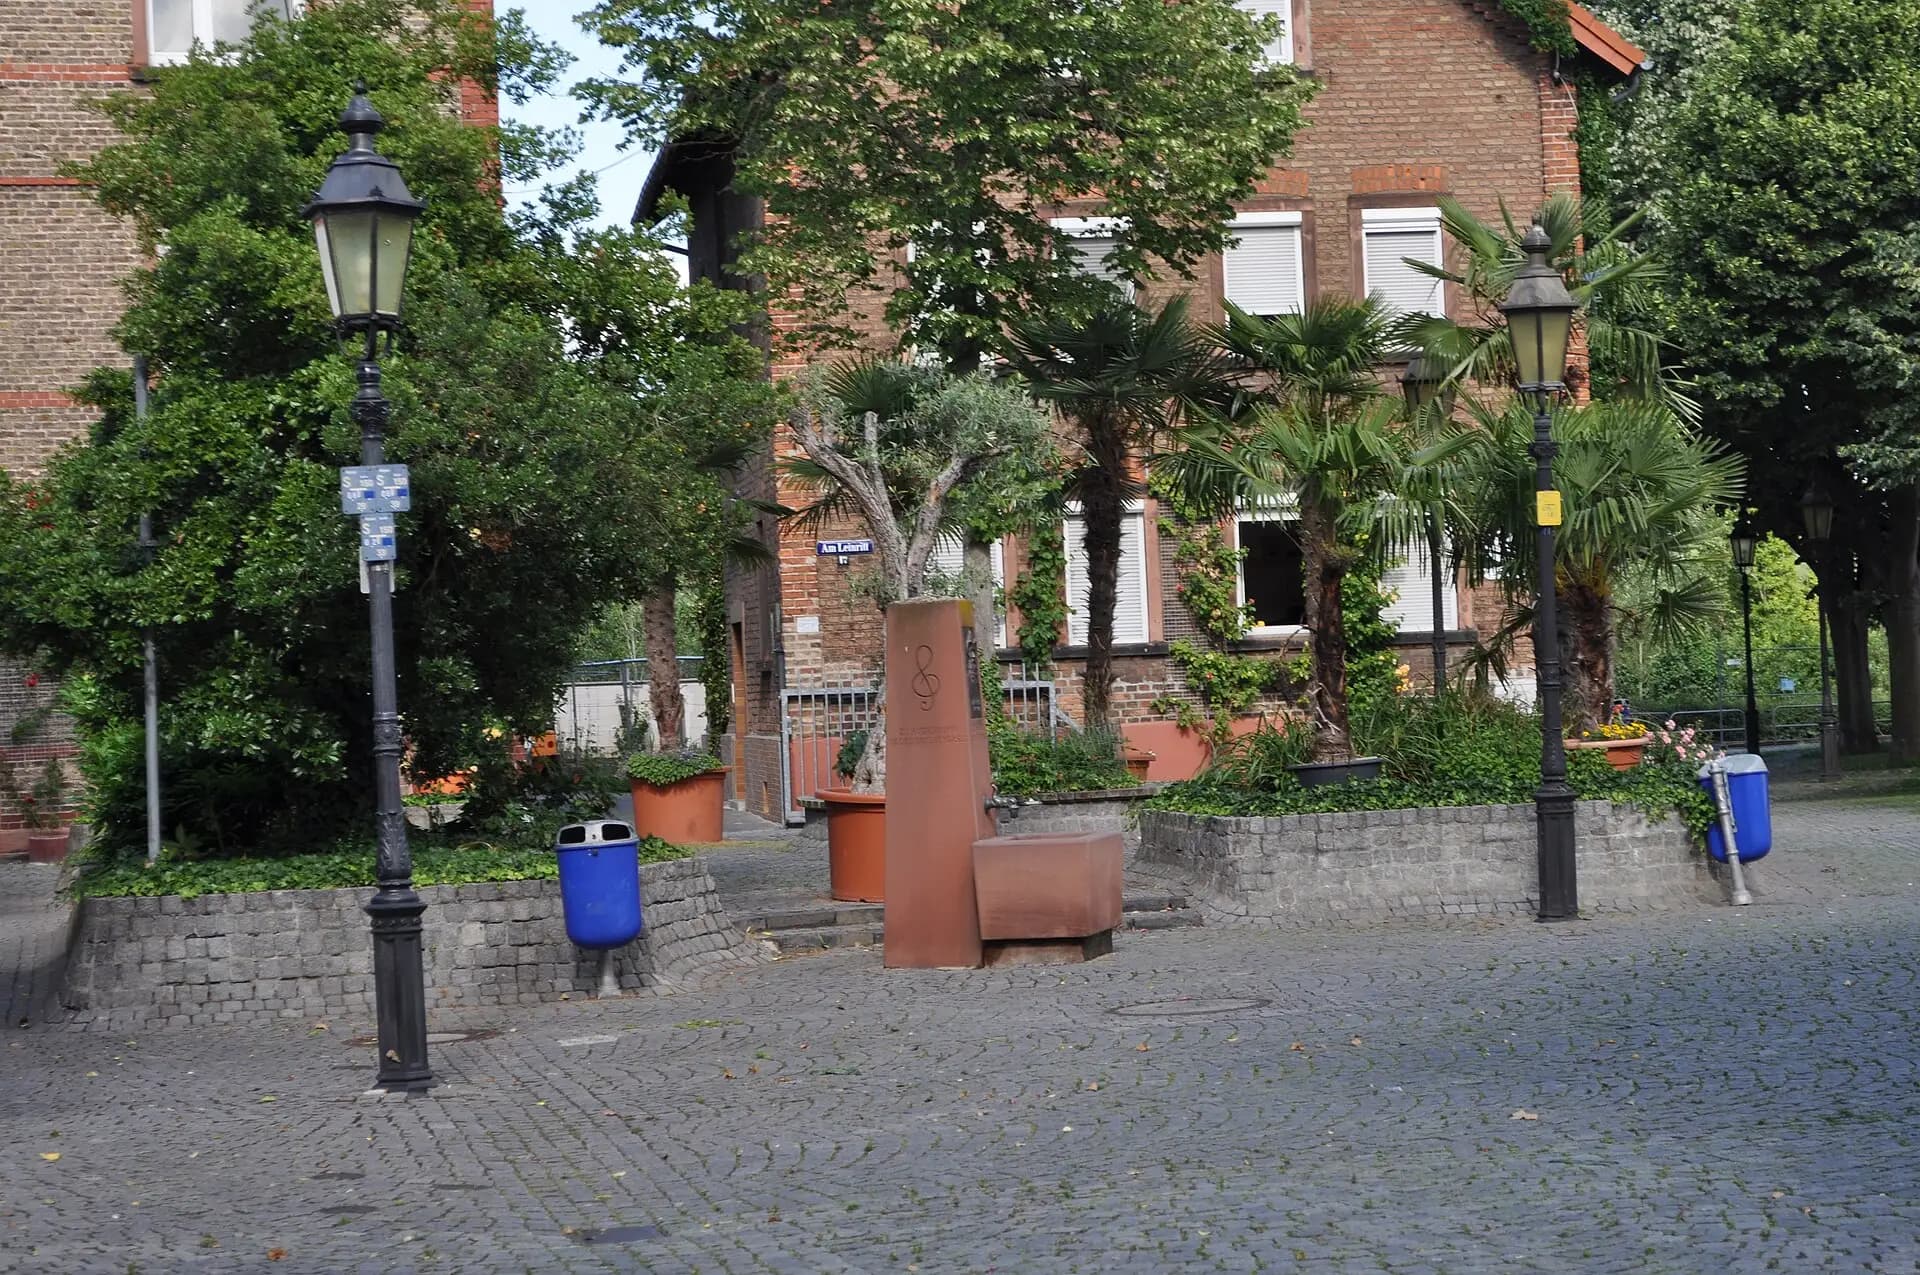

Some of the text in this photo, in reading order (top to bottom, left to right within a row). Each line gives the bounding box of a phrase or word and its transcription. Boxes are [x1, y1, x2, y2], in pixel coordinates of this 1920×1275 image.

[376, 474, 384, 486] S
[362, 523, 370, 535] S
[821, 543, 837, 553] Am
